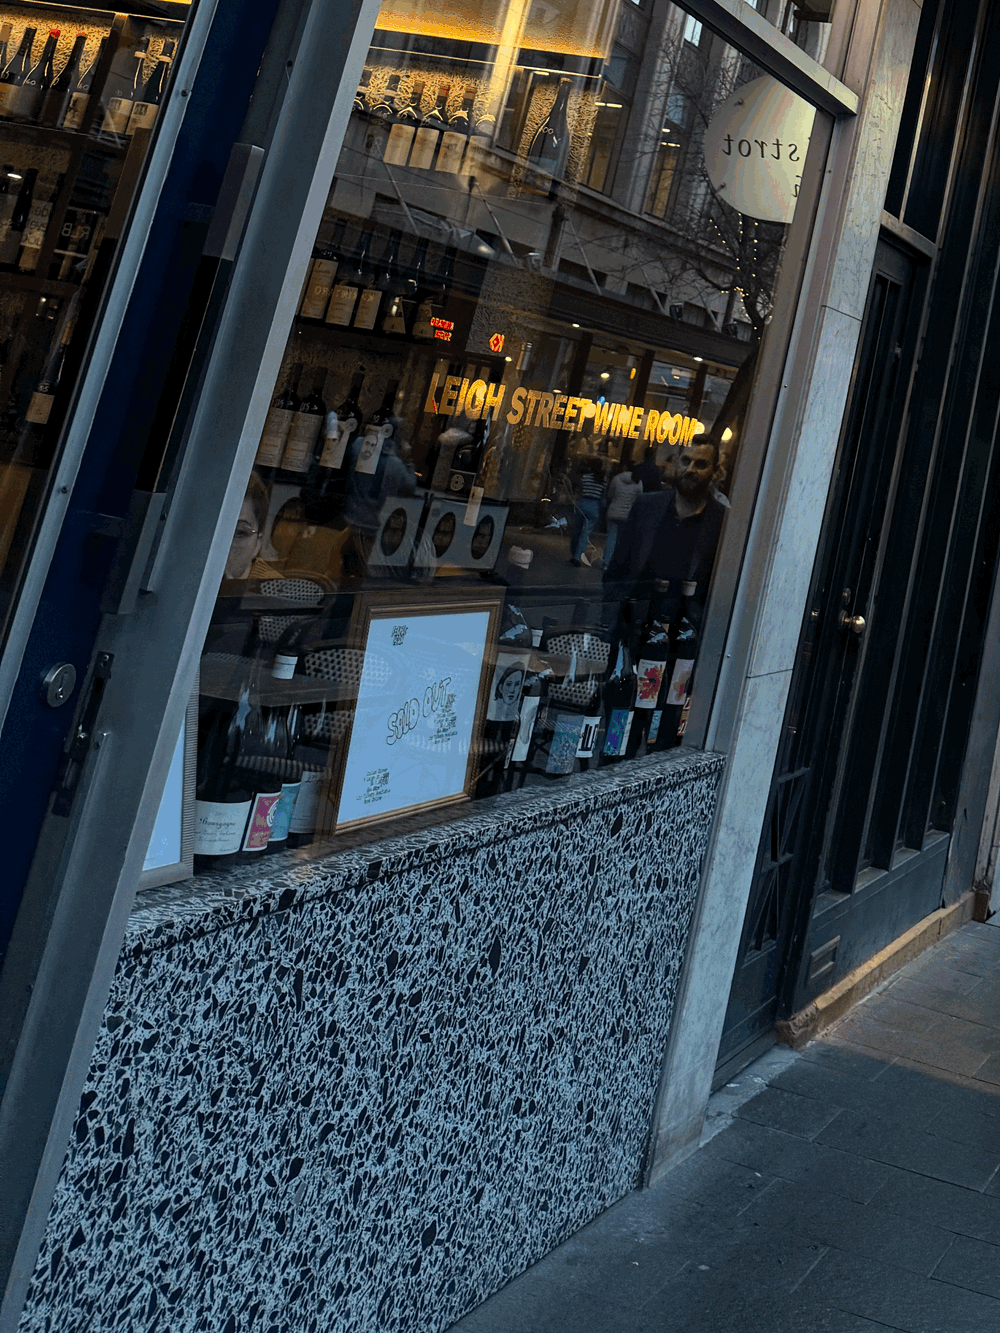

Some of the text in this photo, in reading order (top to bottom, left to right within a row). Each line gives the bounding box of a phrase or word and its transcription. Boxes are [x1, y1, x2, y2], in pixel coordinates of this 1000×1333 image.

[424, 373, 699, 448] LEIGH STREET WINE ROOM
[386, 697, 420, 746] SOLD
[422, 677, 452, 718] OUT
